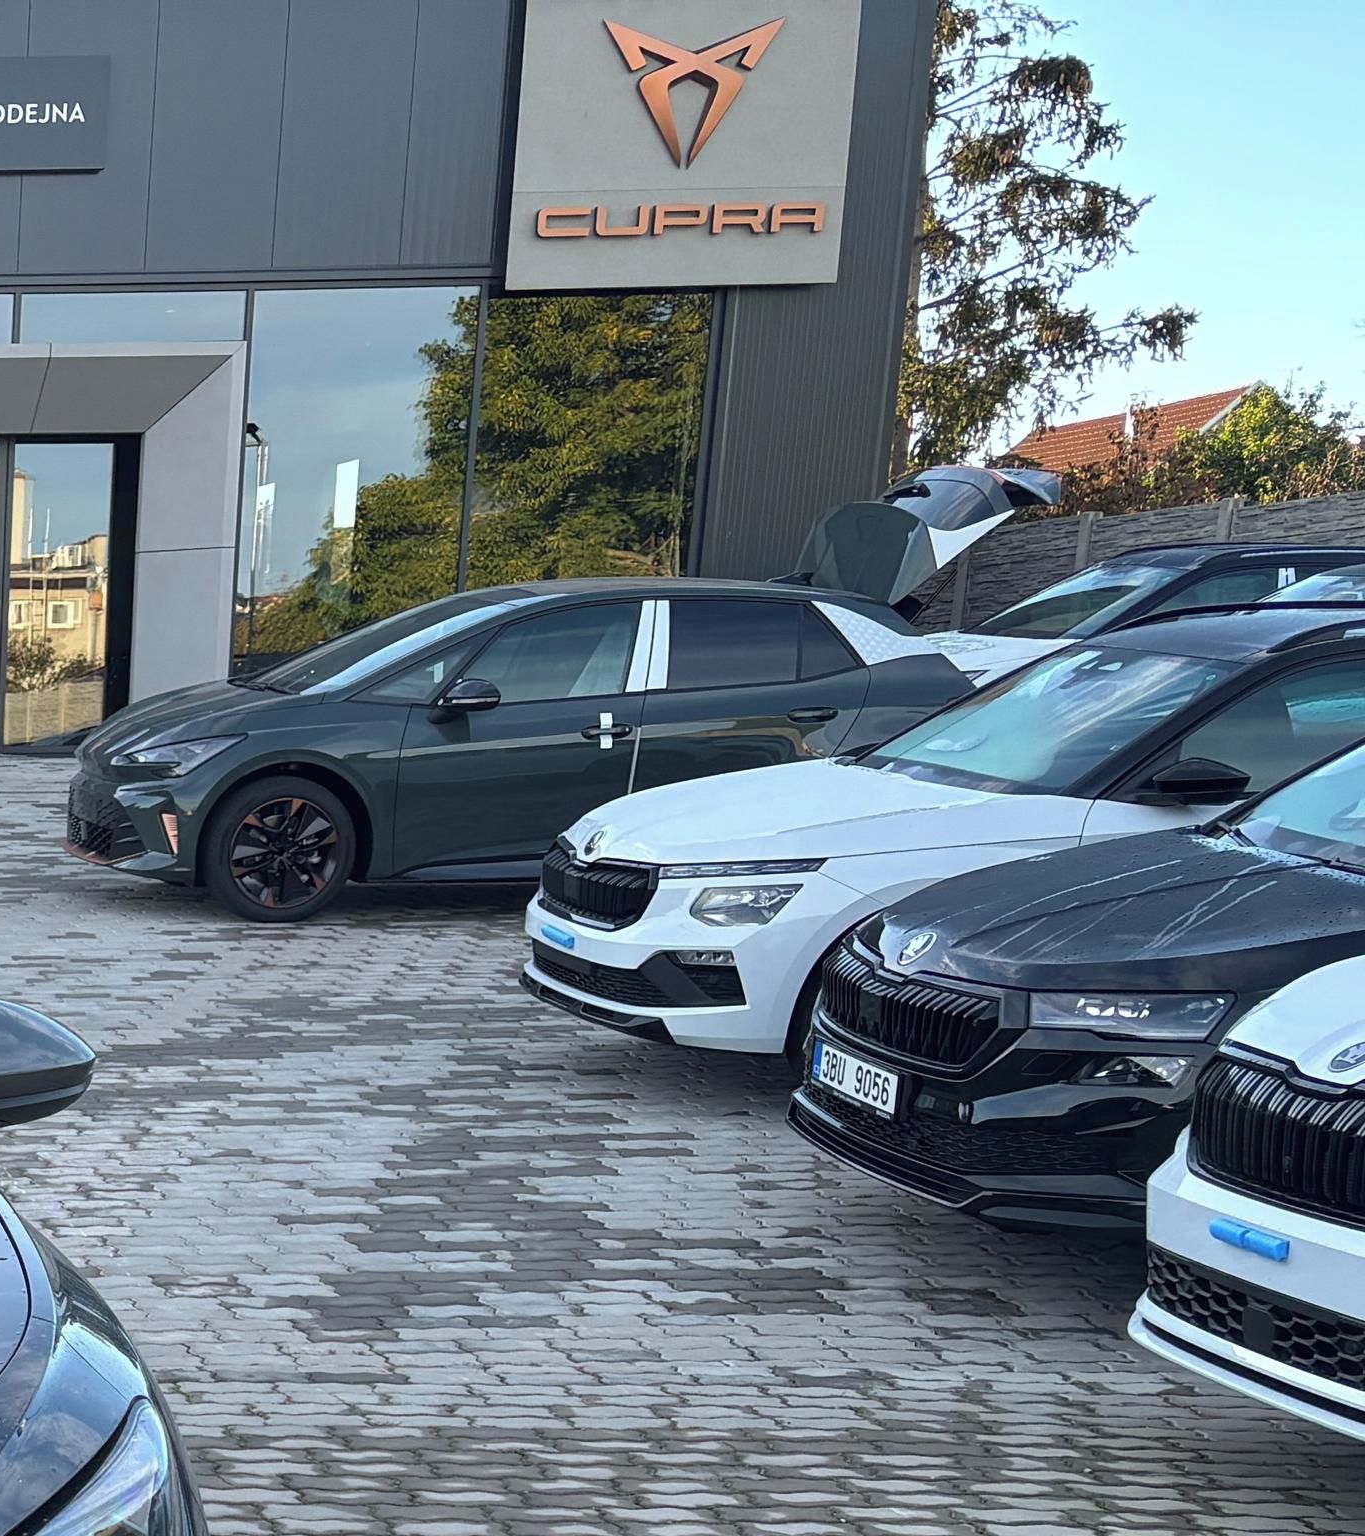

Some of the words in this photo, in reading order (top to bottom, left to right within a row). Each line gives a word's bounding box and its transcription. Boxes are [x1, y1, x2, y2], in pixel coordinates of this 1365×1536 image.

[535, 202, 826, 238] CUPRA
[822, 1050, 846, 1086] 3BU
[854, 1065, 891, 1106] 9056
